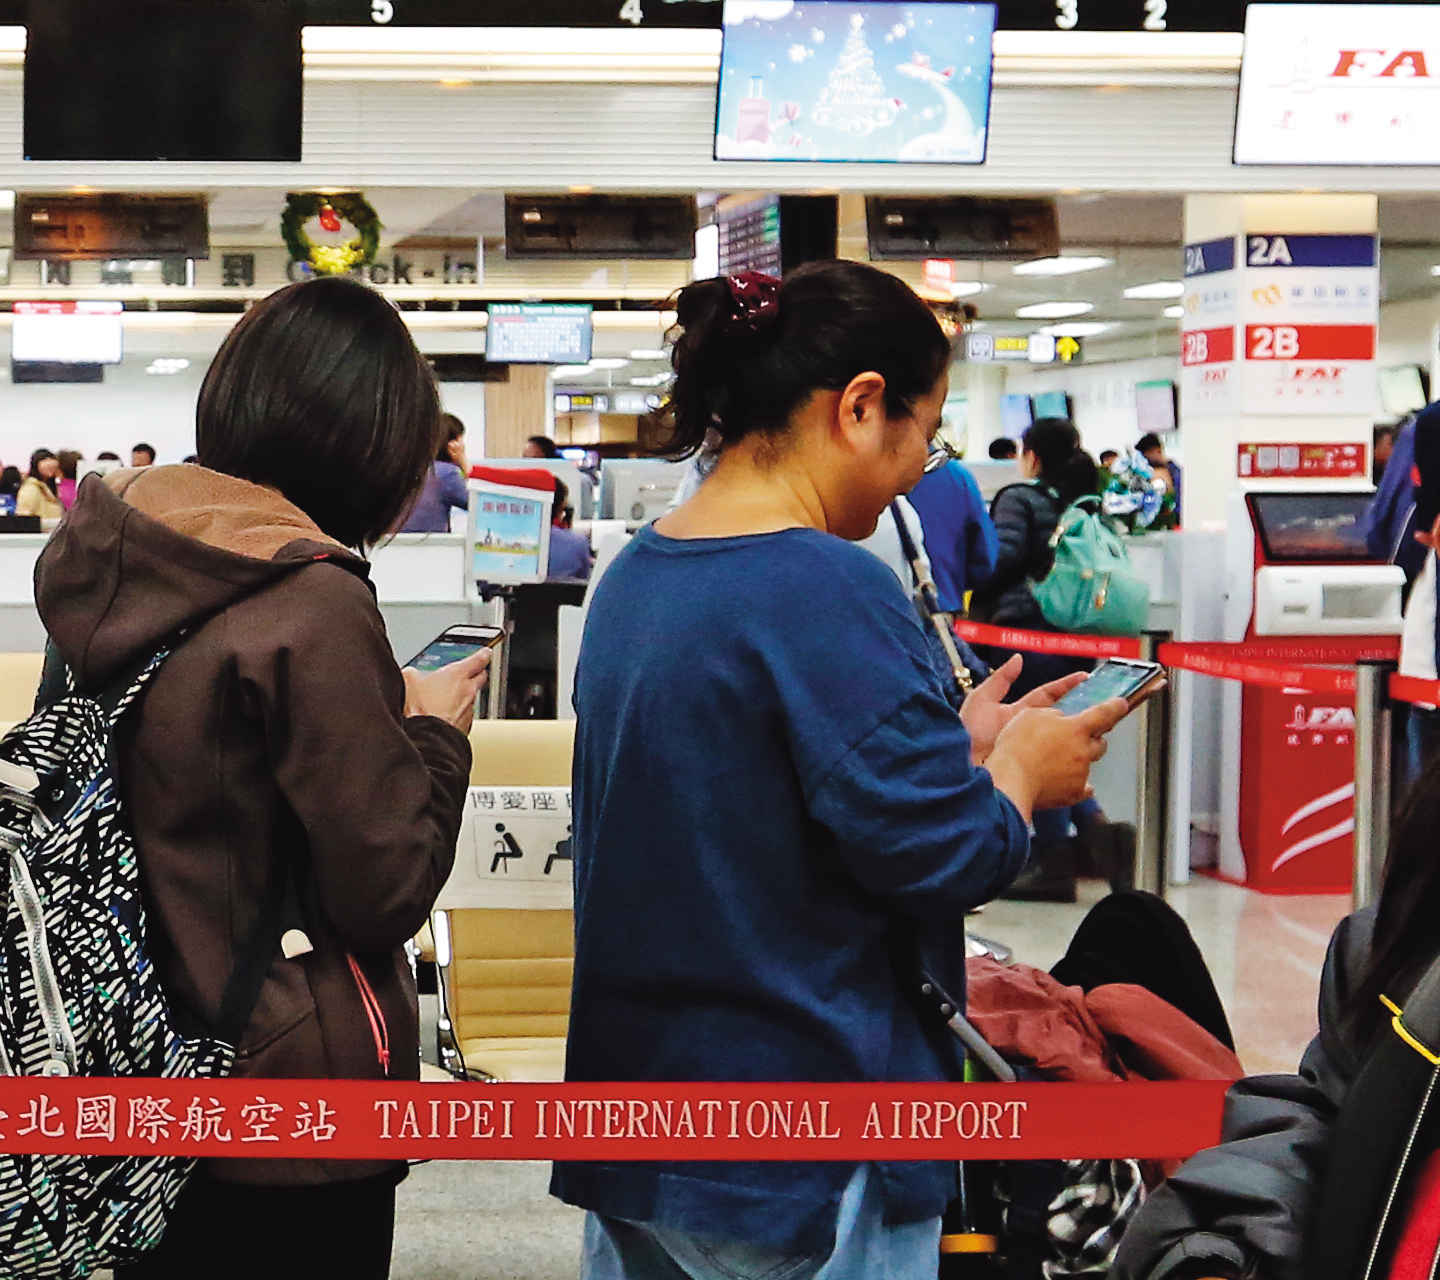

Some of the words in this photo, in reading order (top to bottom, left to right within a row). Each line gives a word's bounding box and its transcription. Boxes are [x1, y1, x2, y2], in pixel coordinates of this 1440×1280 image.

[1186, 246, 1205, 275] 2A
[1248, 236, 1293, 265] 2A
[1186, 332, 1208, 363] 2B
[1251, 327, 1300, 358] 2B
[1308, 706, 1355, 728] FA
[471, 791, 557, 811] 博愛座
[373, 1100, 515, 1139] TAIPEI
[534, 1100, 841, 1140] INTERNATIONAL
[860, 1101, 1027, 1140] AIRPORT
